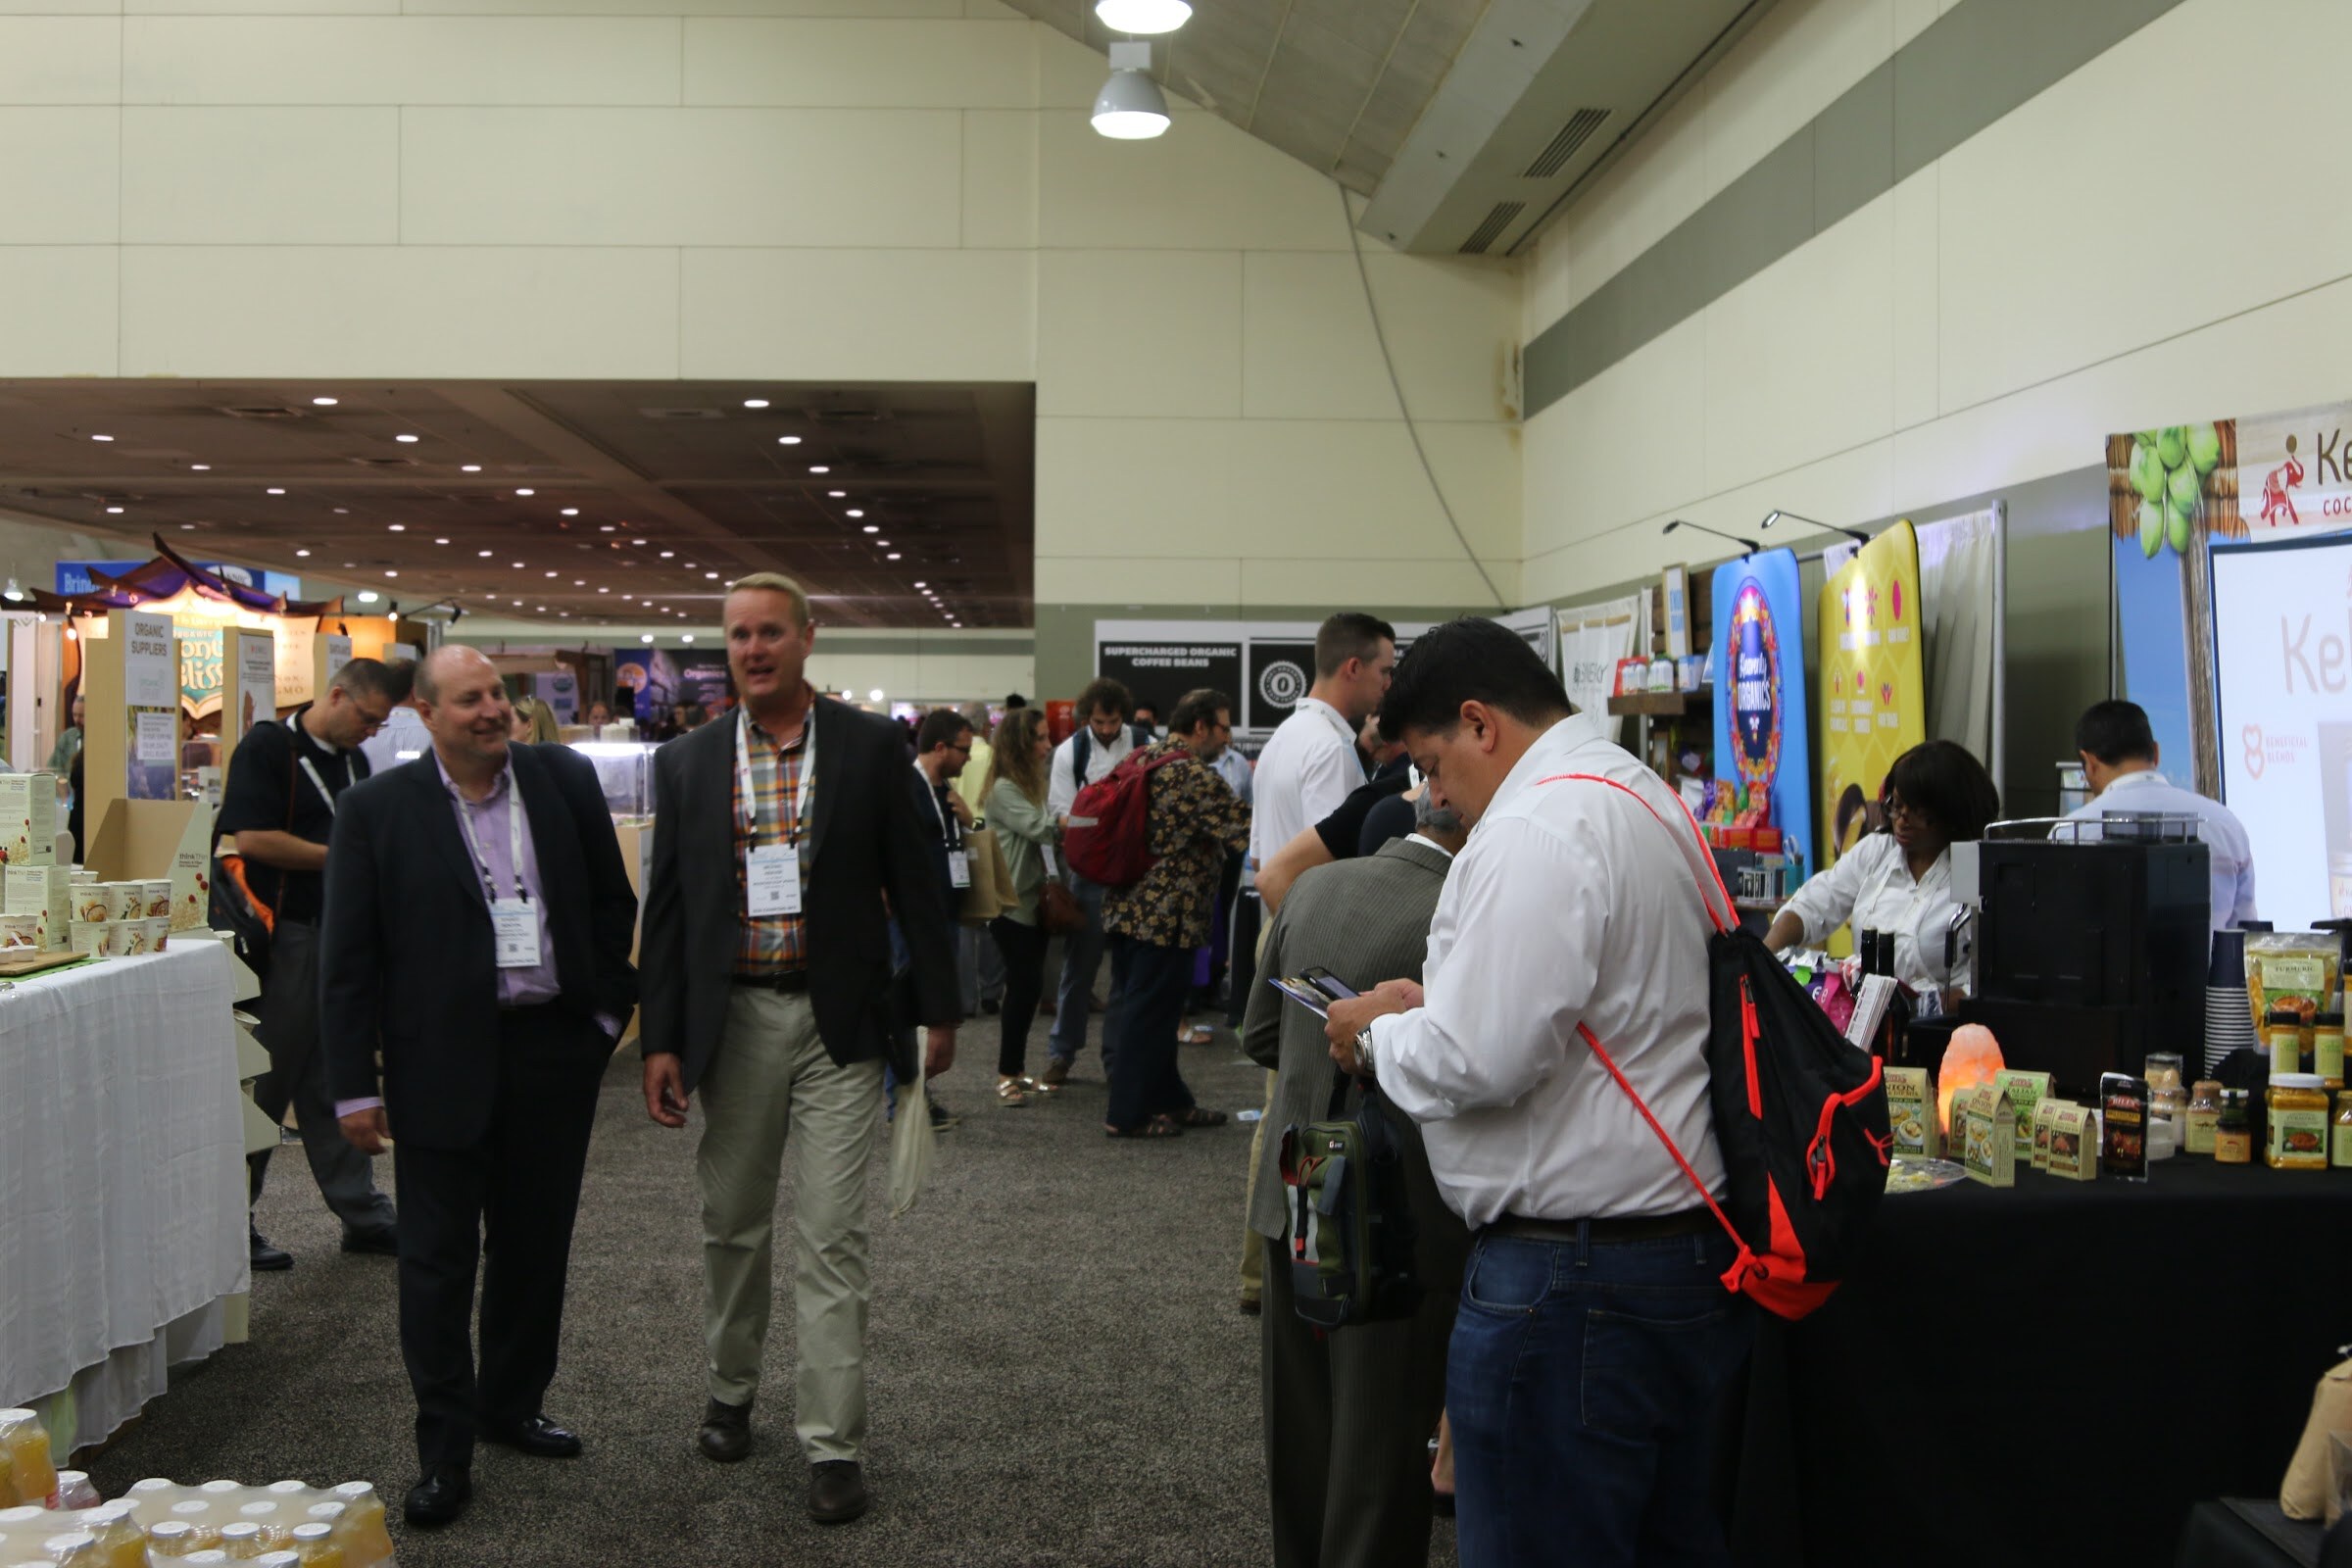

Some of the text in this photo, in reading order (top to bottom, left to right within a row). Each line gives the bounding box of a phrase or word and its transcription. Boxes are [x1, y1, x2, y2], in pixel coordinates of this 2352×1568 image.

[134, 621, 165, 638] ORGANIC
[130, 640, 168, 658] SUPPLIERS
[1104, 647, 1237, 657] SUPERCHARGED ORGANIC
[1132, 658, 1210, 667] COFFEE BEANS
[1738, 680, 1772, 711] ORGANICS
[1886, 1083, 1917, 1092] NION
[2007, 1087, 2037, 1096] TALIAN
